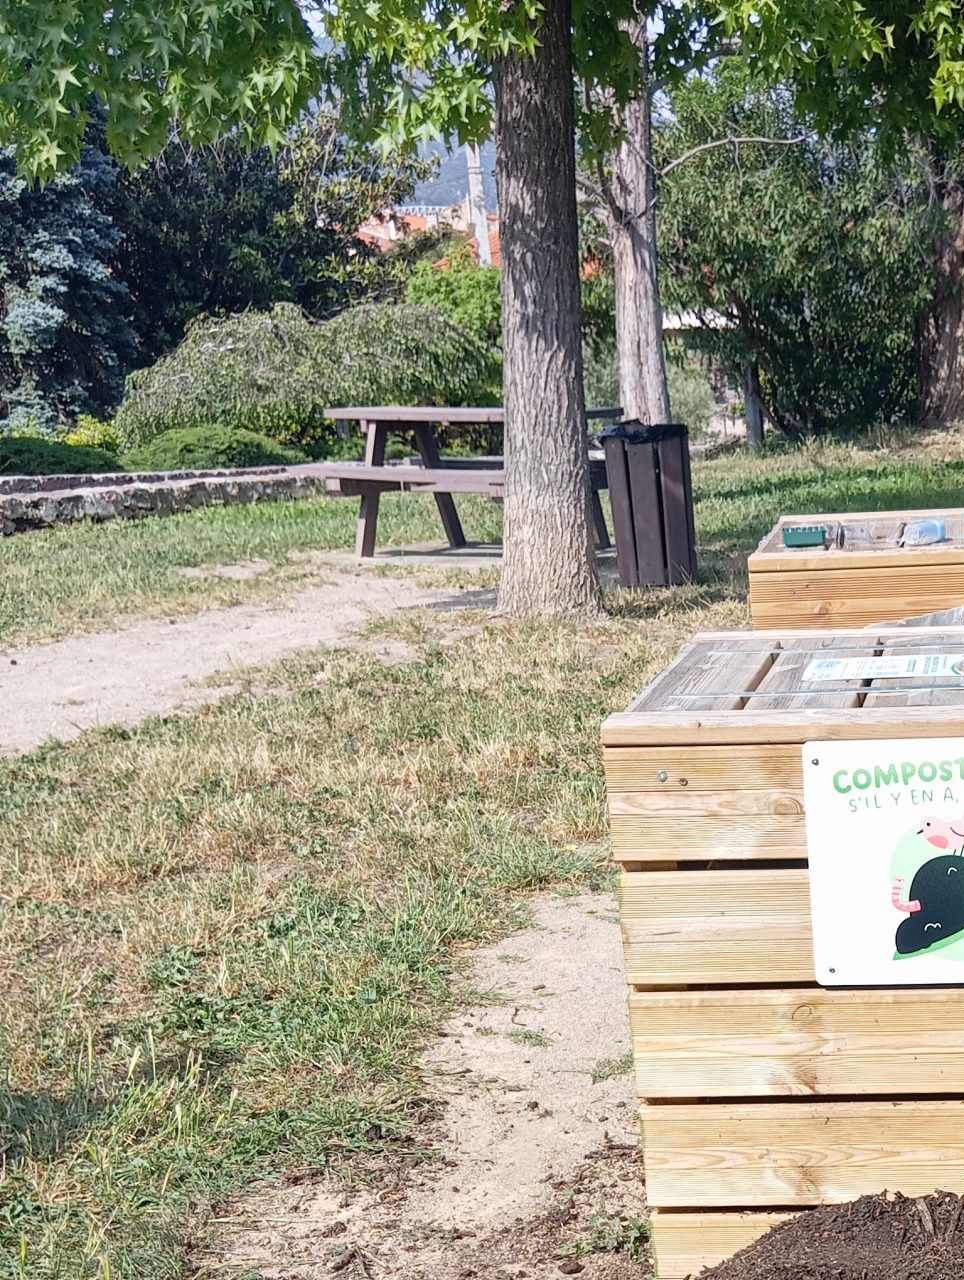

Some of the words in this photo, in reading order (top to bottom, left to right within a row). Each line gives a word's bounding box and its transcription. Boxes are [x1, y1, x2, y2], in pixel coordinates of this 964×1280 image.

[848, 794, 883, 813] S'IL
[890, 791, 901, 806] Y
[910, 788, 934, 806] EN
[943, 786, 960, 804] A,
